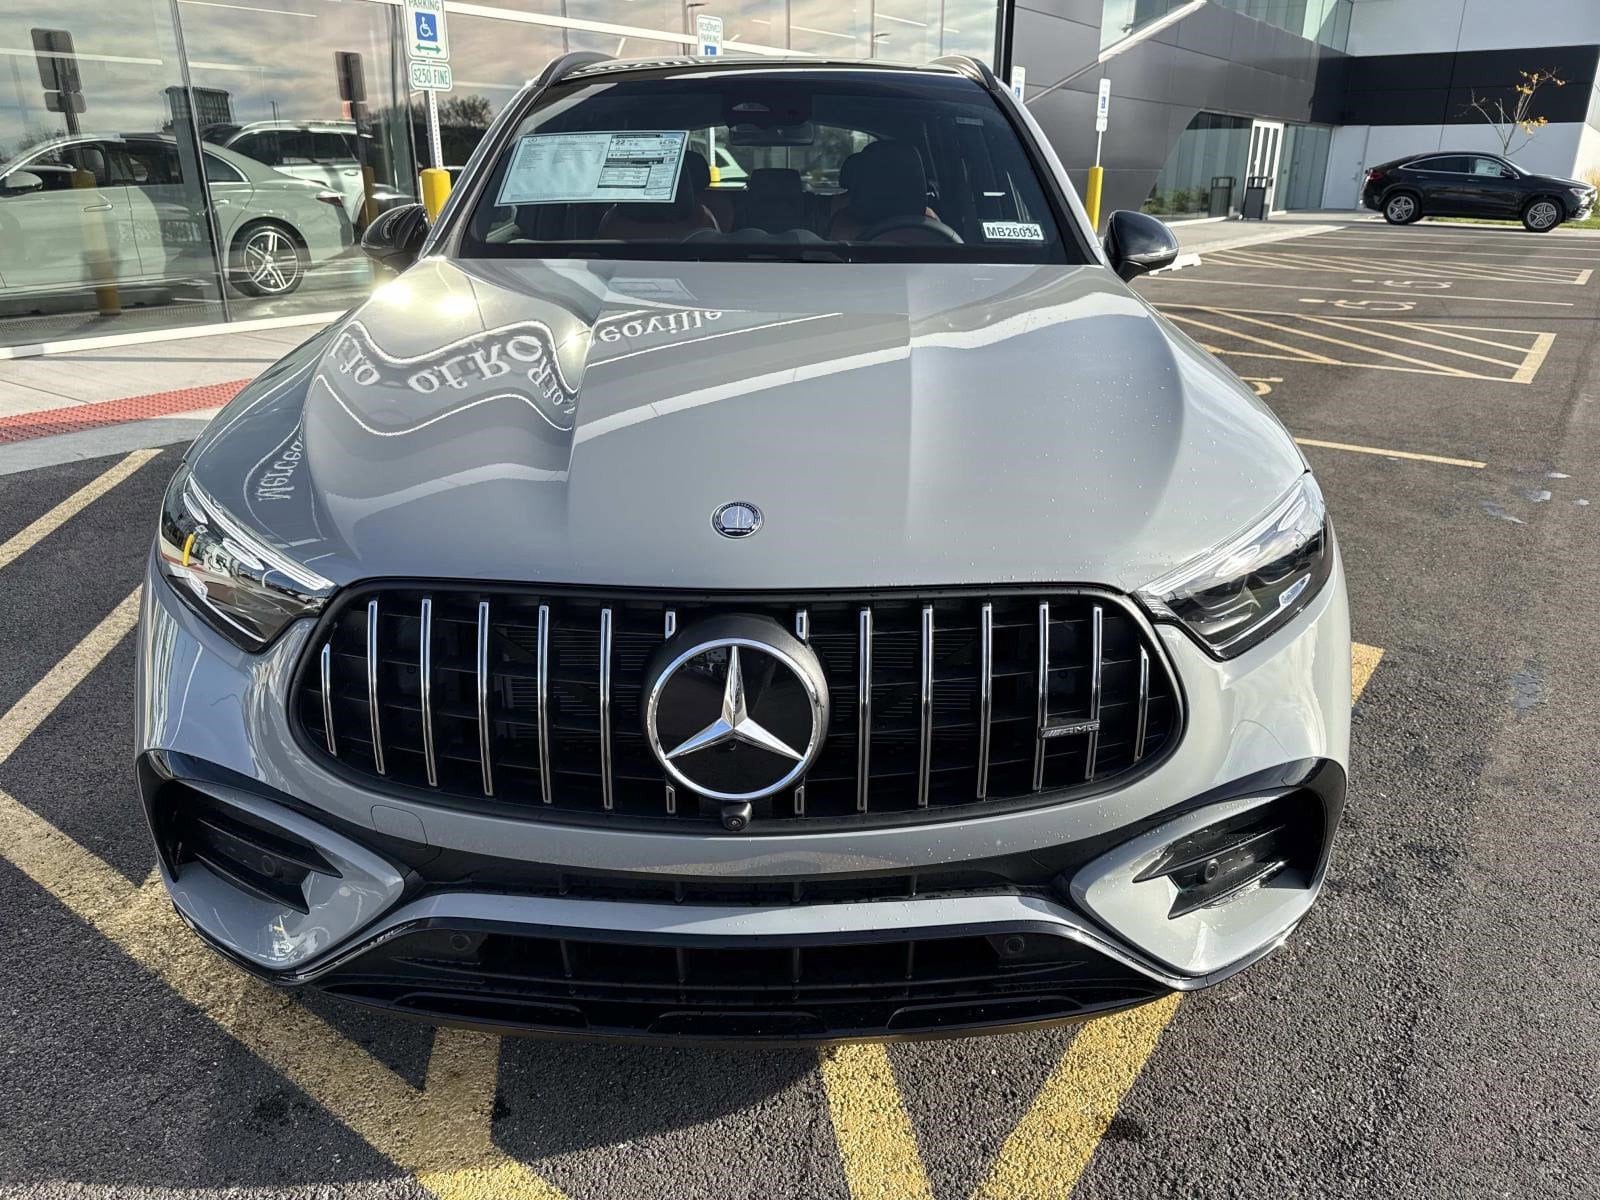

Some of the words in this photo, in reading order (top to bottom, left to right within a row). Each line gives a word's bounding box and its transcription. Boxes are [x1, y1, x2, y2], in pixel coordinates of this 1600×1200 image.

[413, 68, 432, 84] $250
[433, 69, 449, 85] FINE
[986, 226, 1041, 238] MB26034
